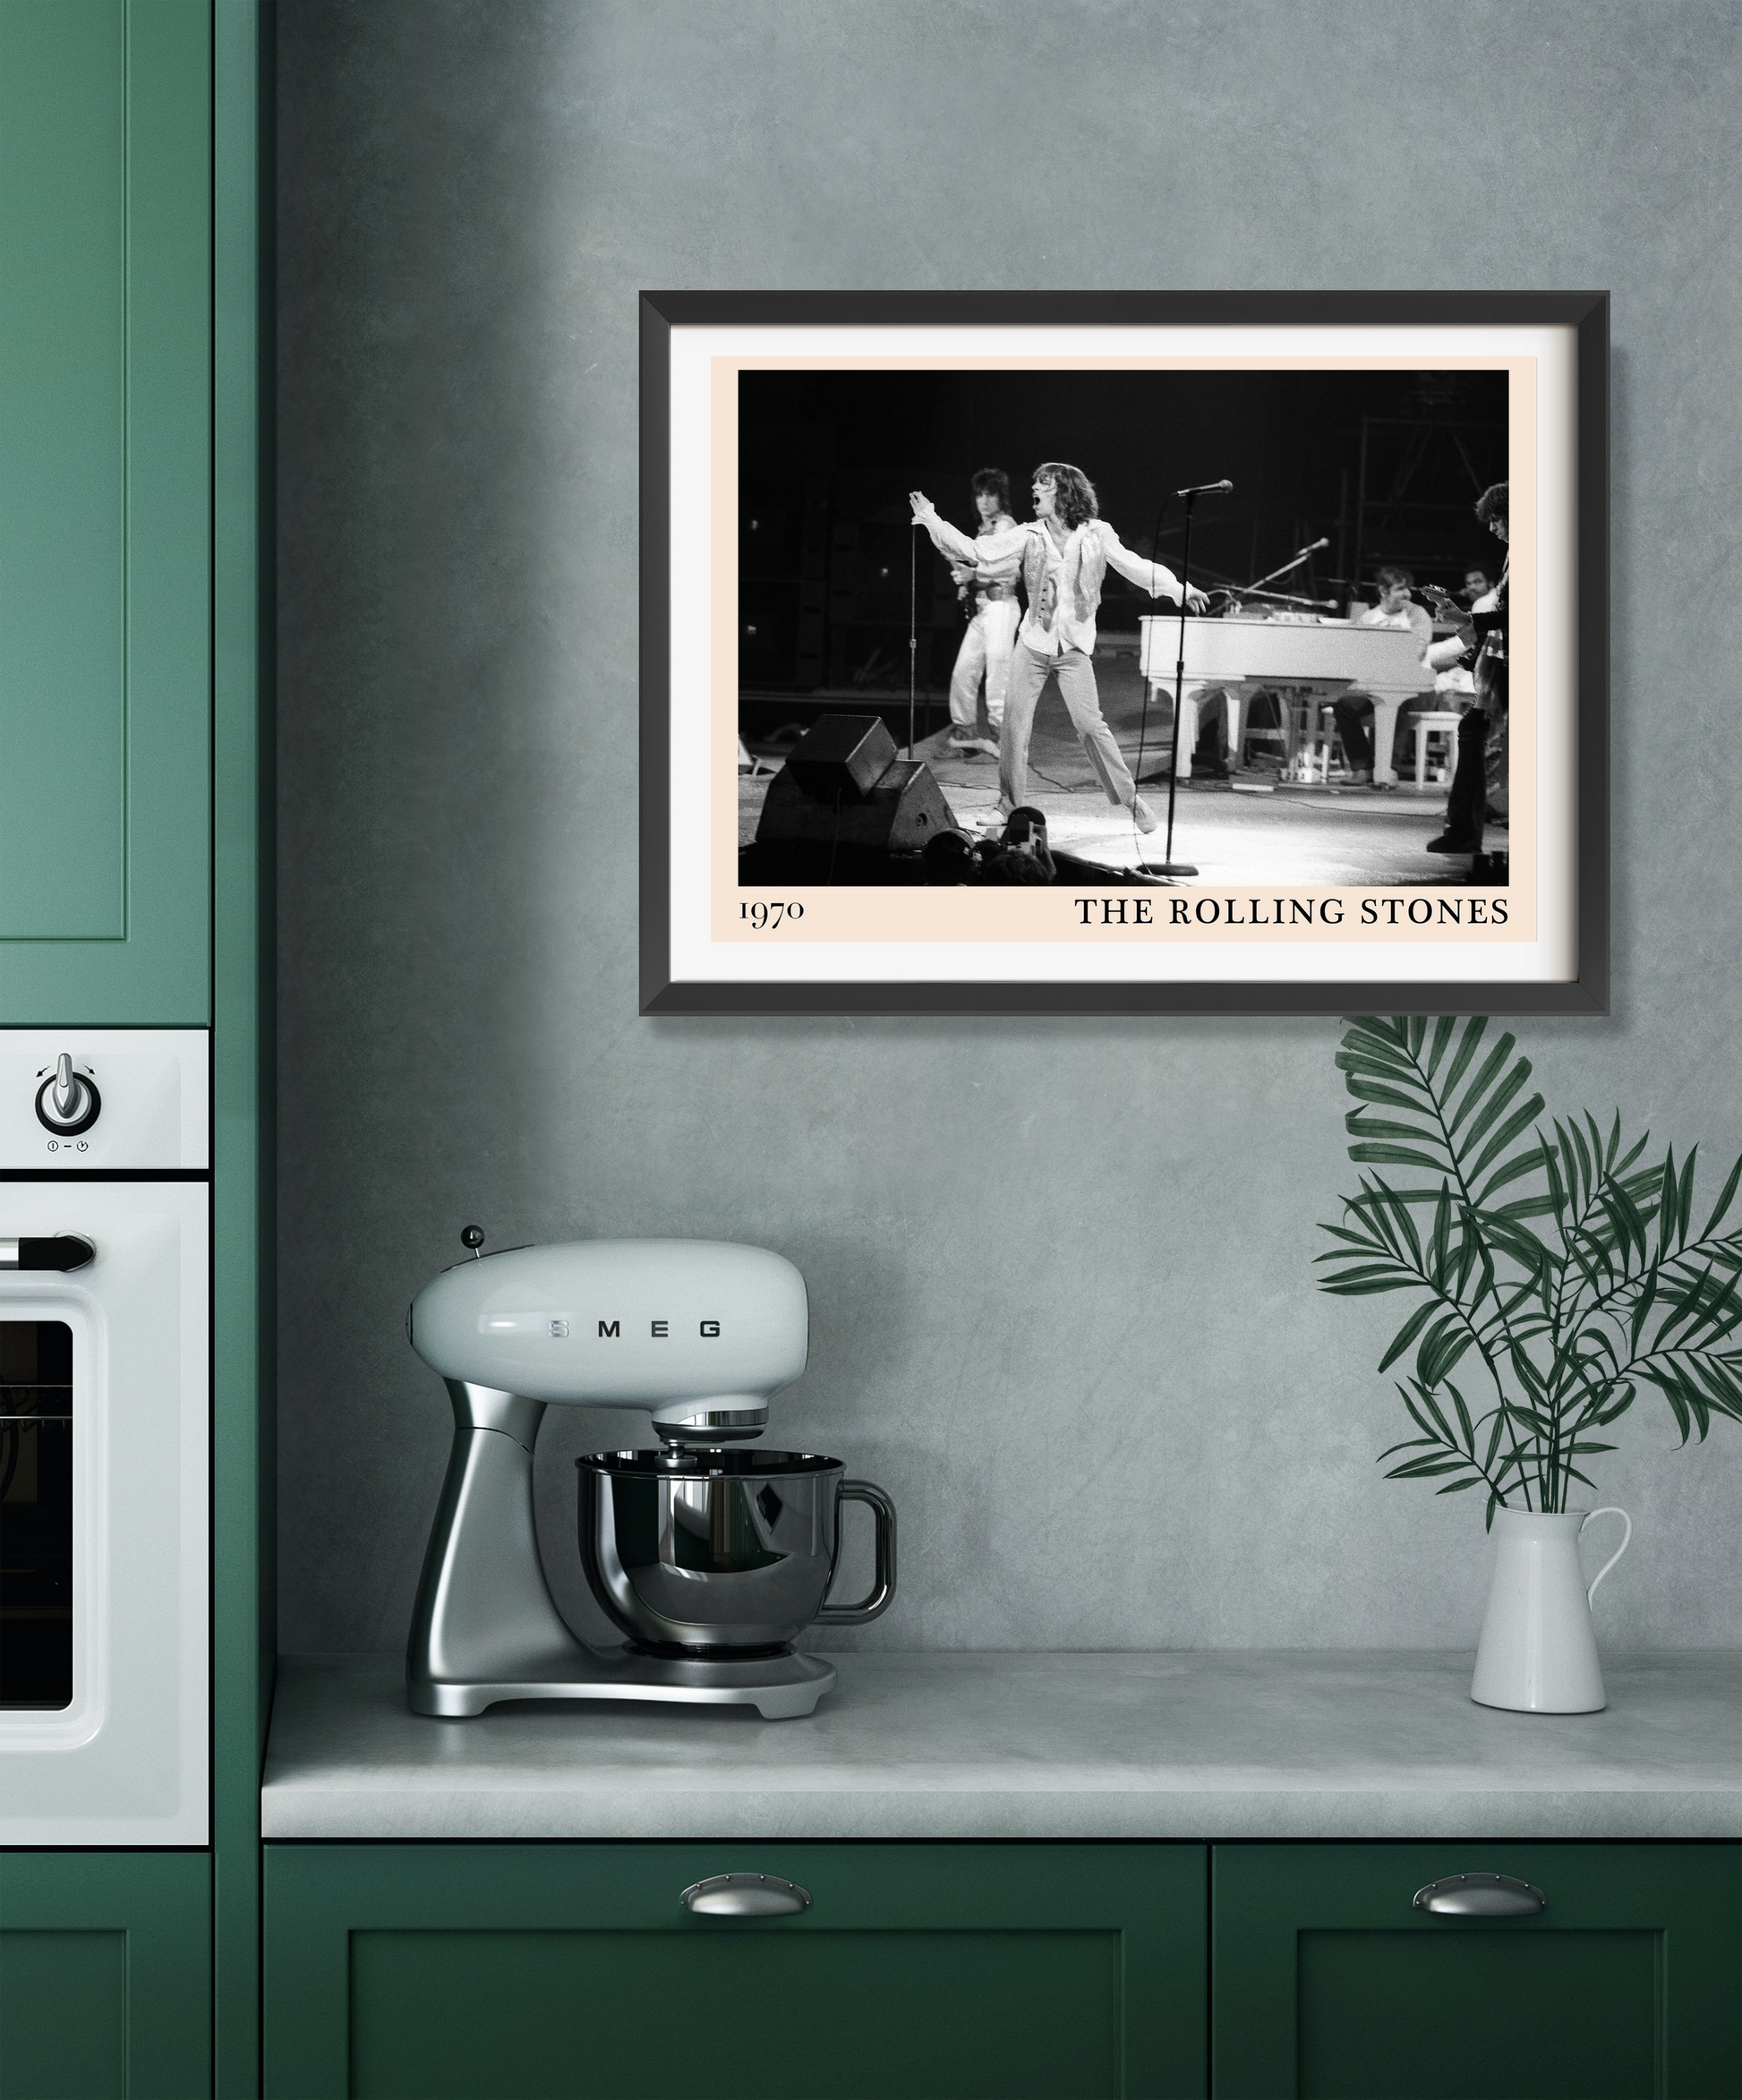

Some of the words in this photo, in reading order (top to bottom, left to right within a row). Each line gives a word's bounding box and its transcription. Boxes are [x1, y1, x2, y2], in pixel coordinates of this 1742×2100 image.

[739, 901, 805, 930] 1970
[1074, 899, 1153, 925] THE
[1168, 898, 1345, 925] ROLLING
[1361, 898, 1508, 925] STONES
[549, 1319, 721, 1338] SMEG
